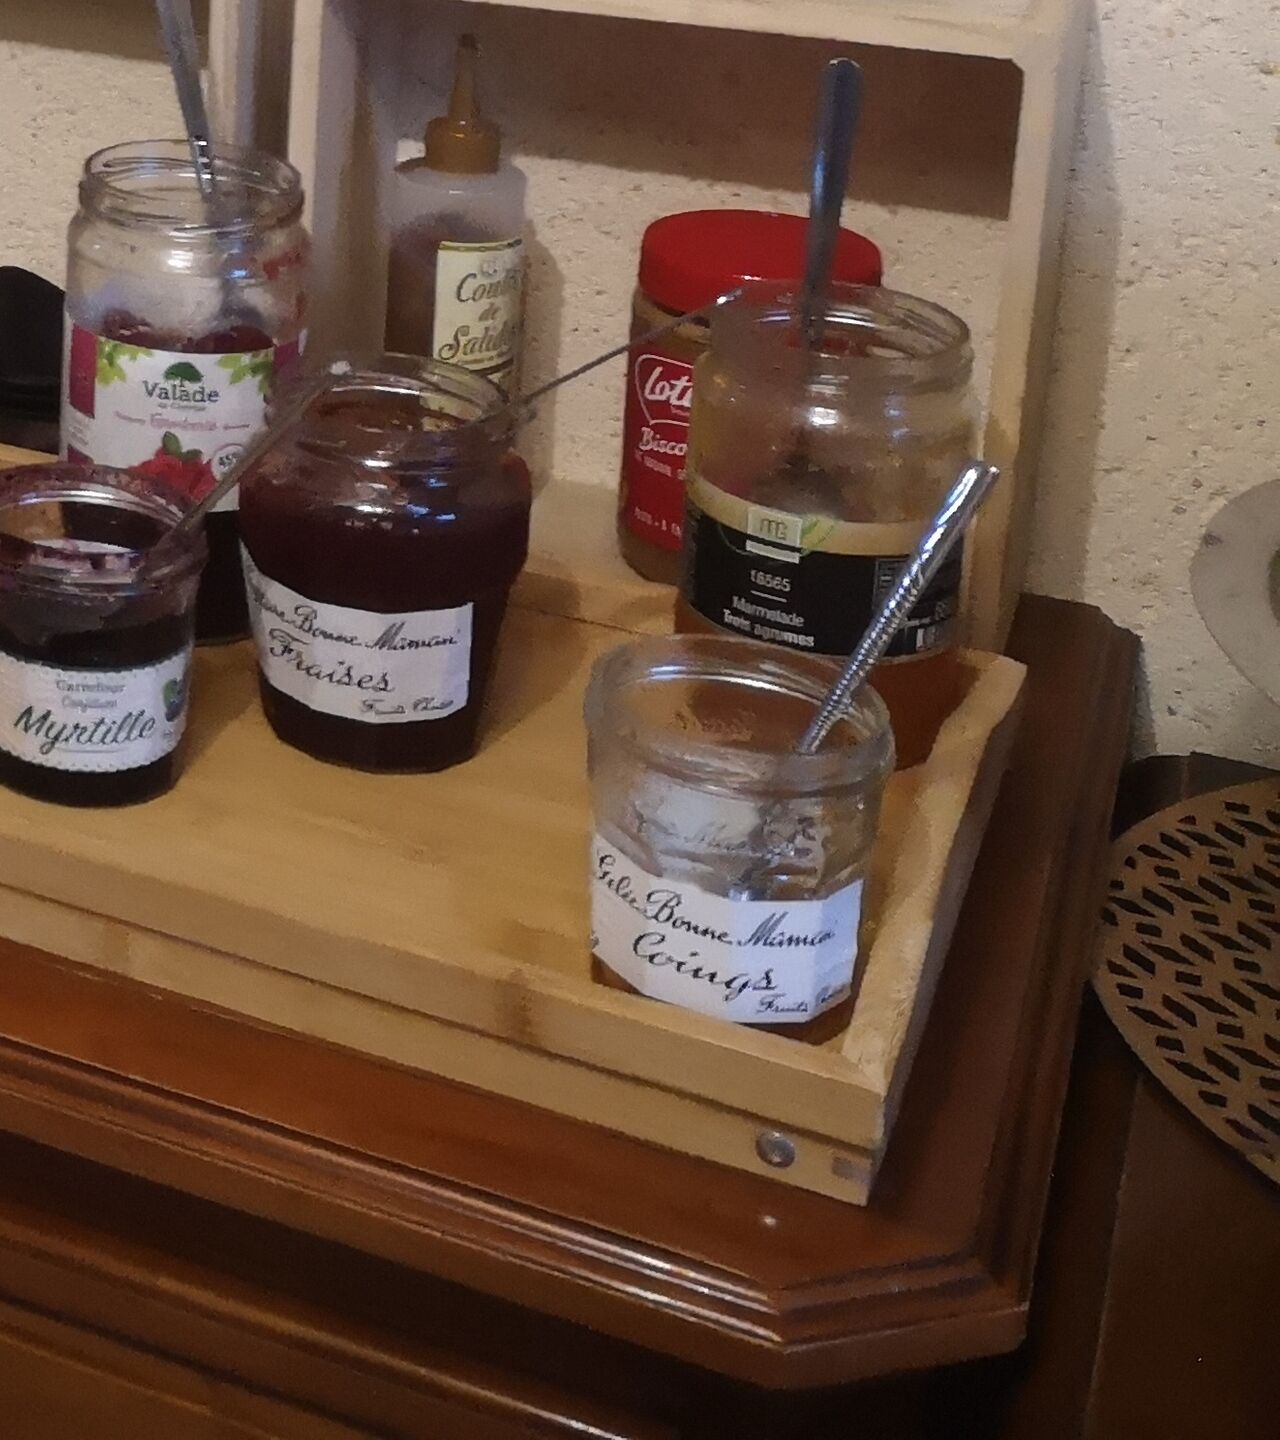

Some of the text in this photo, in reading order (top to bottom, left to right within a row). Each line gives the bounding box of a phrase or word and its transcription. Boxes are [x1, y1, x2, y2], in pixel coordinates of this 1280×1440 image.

[142, 379, 221, 404] Valade
[639, 426, 688, 456] Bisco
[288, 604, 363, 647] Bonne
[268, 627, 395, 693] Fraises
[13, 705, 156, 756] Myrtille
[636, 888, 734, 946] Bonne
[632, 931, 777, 1003] Coings
